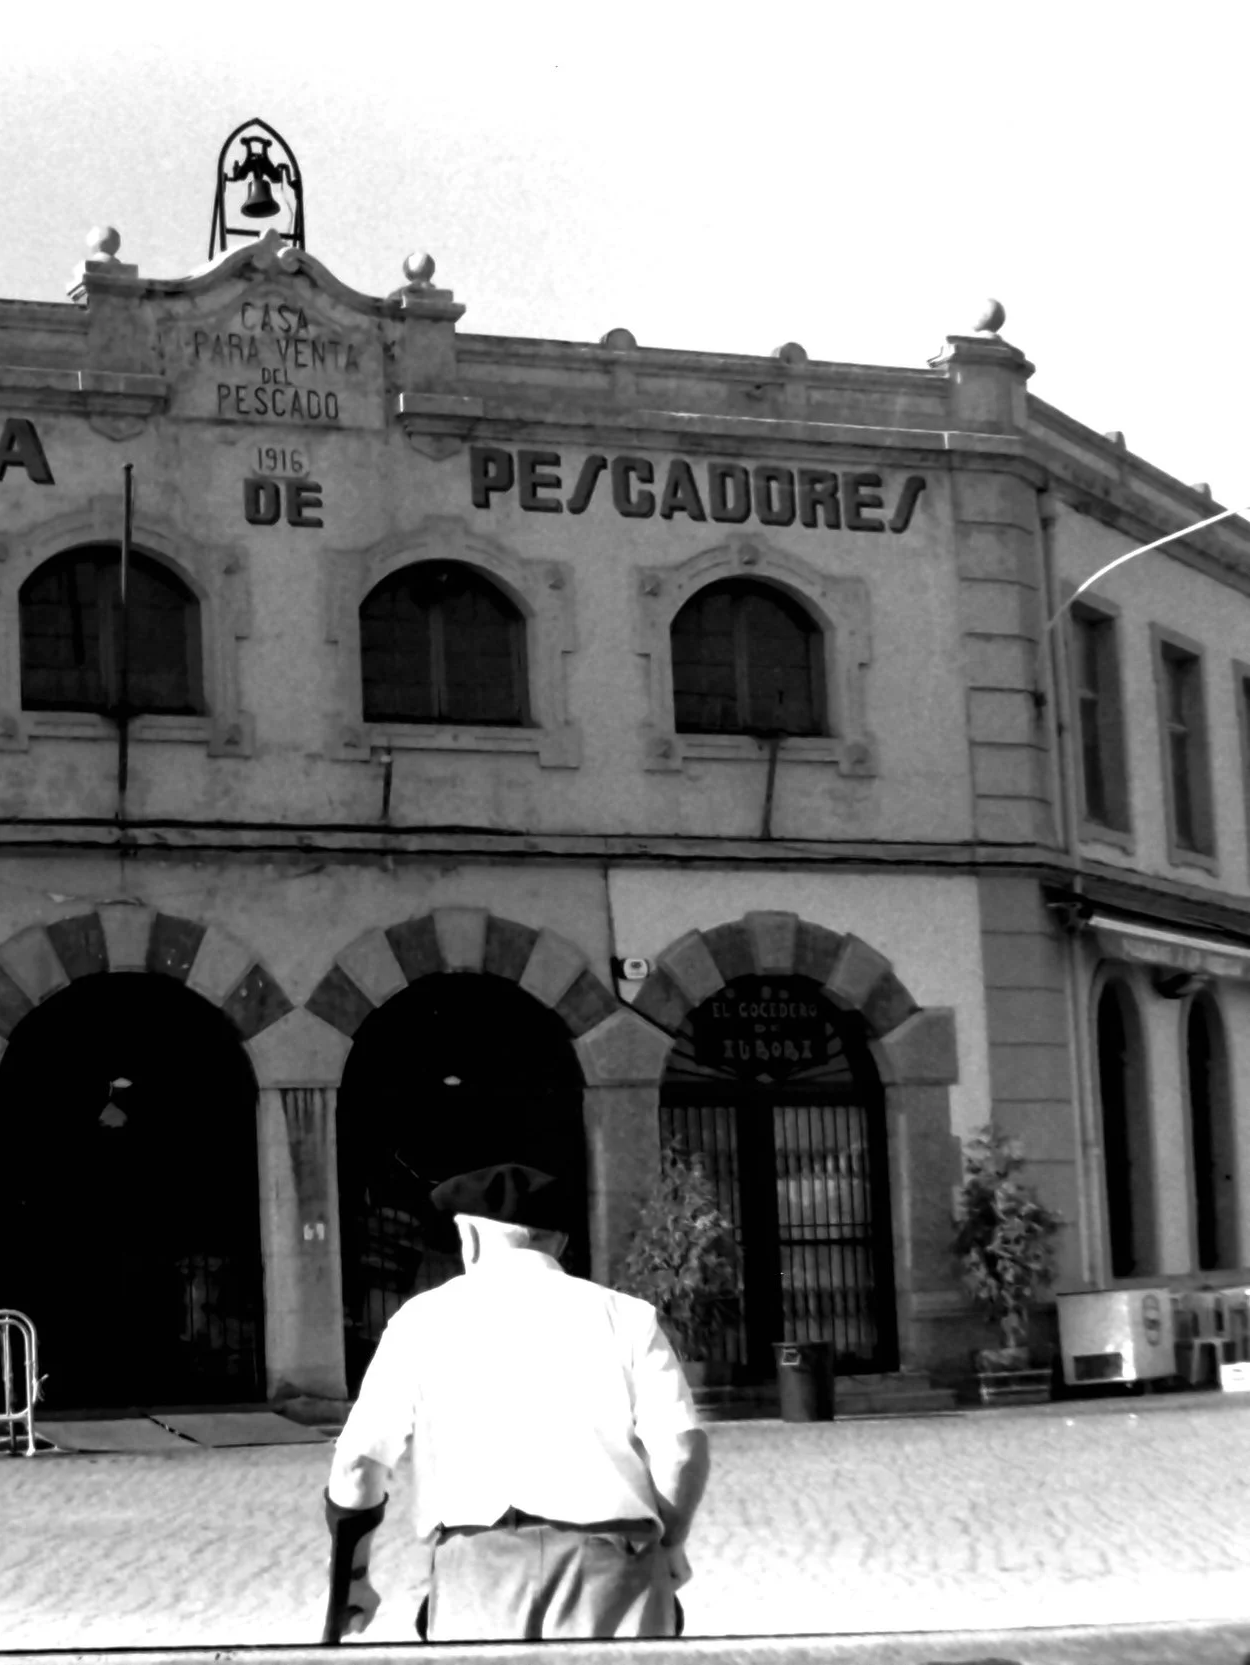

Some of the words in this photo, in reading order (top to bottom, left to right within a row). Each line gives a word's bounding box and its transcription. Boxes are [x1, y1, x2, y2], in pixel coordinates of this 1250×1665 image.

[241, 302, 309, 334] CASA
[194, 331, 260, 363] PARA
[277, 339, 360, 373] VENTA
[261, 367, 293, 386] DEL
[217, 384, 340, 420] PESCADO
[257, 447, 304, 473] 1916
[244, 477, 324, 528] DE
[712, 1002, 731, 1018] EL
